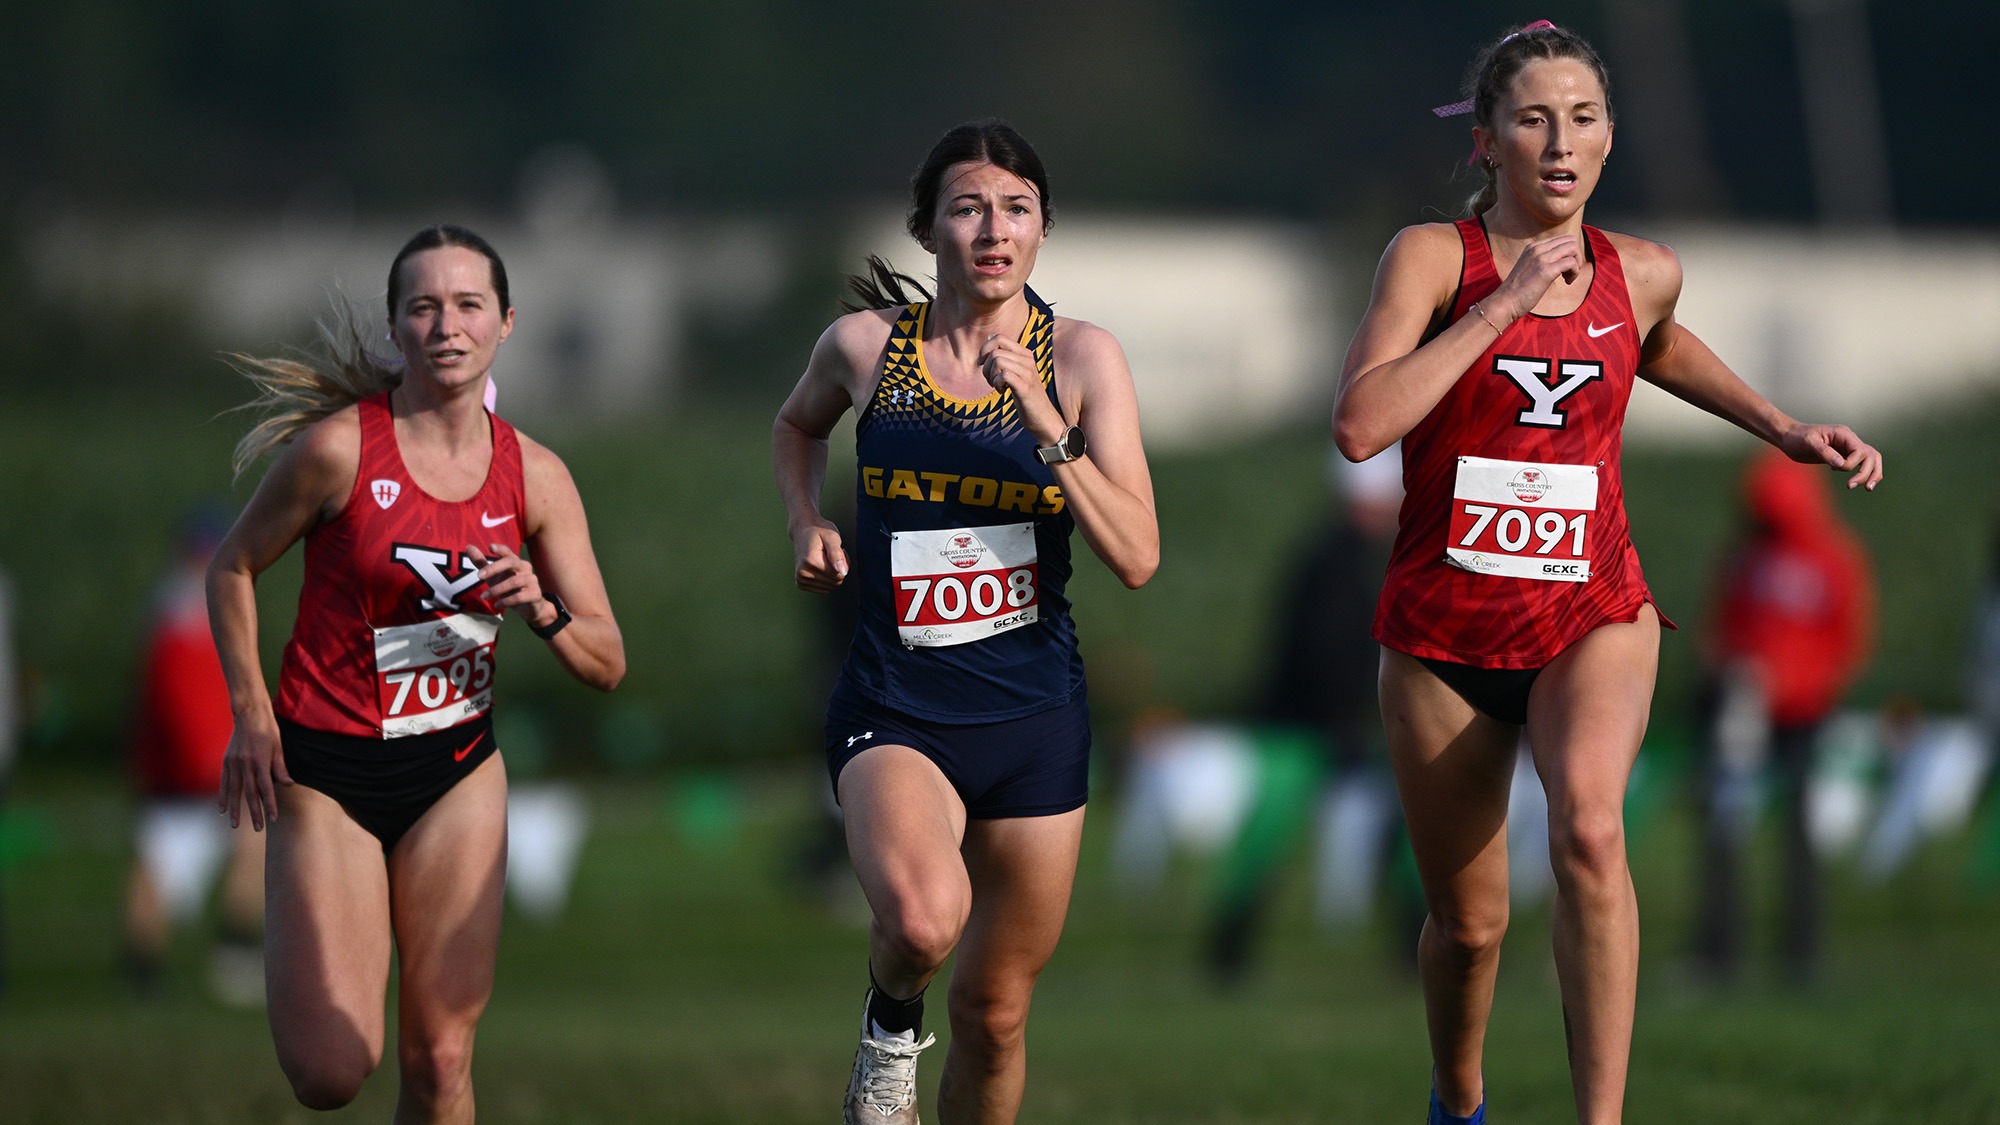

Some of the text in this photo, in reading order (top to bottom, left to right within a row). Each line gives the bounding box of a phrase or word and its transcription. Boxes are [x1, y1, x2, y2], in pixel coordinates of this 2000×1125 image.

[1492, 353, 1604, 430] Y
[862, 466, 1066, 515] GATORS
[1506, 481, 1553, 491] CROSS COUNTRY
[1459, 503, 1588, 557] 7091
[959, 547, 988, 555] COUNTRY
[1481, 561, 1501, 569] CREEK
[390, 542, 502, 612] Y
[1542, 564, 1579, 574] GCXC
[899, 568, 1036, 623] 7008
[933, 632, 953, 640] CREEK
[993, 612, 1029, 629] GCXC
[384, 645, 492, 717] 7095
